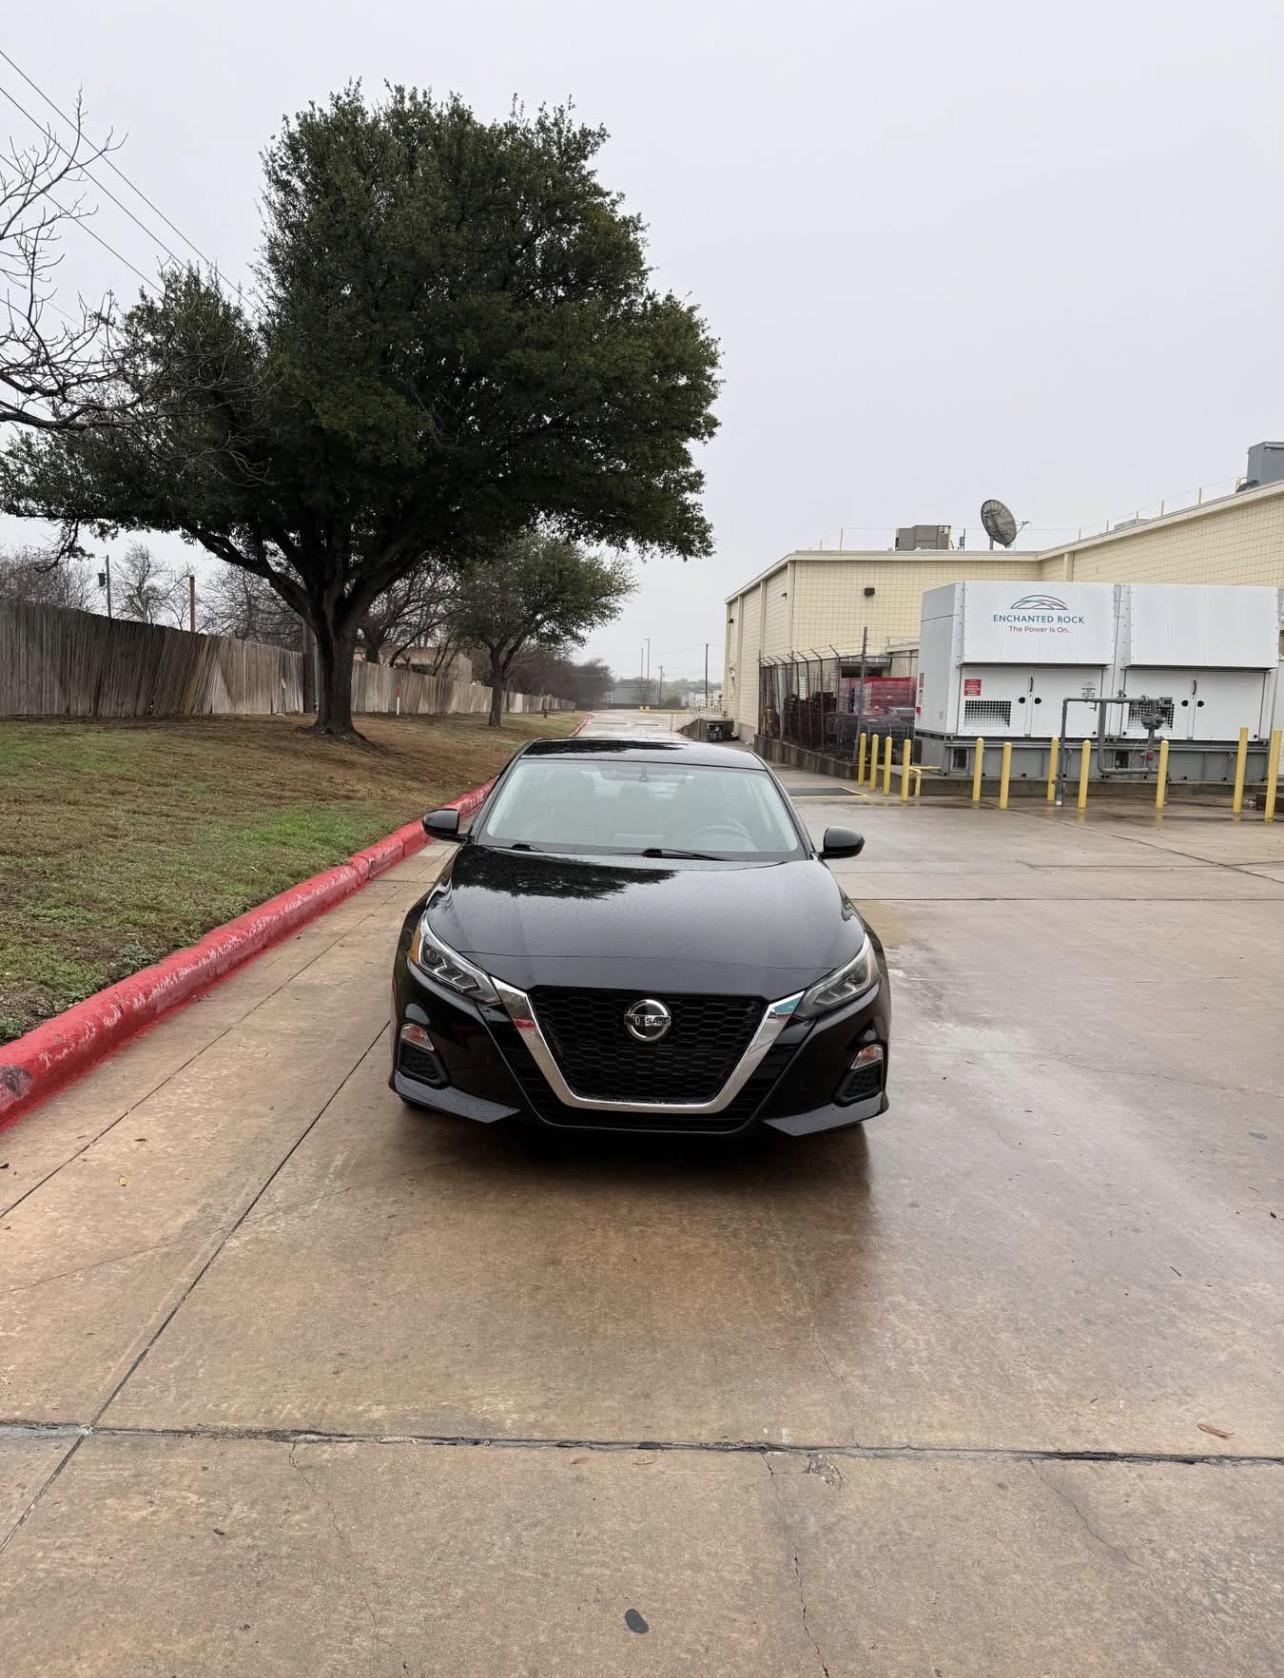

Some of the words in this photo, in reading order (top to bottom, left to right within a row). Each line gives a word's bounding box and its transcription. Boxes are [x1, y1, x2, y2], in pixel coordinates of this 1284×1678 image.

[993, 614, 1054, 623] ENCHANTED
[1057, 615, 1085, 624] ROCK
[1009, 625, 1022, 633] The
